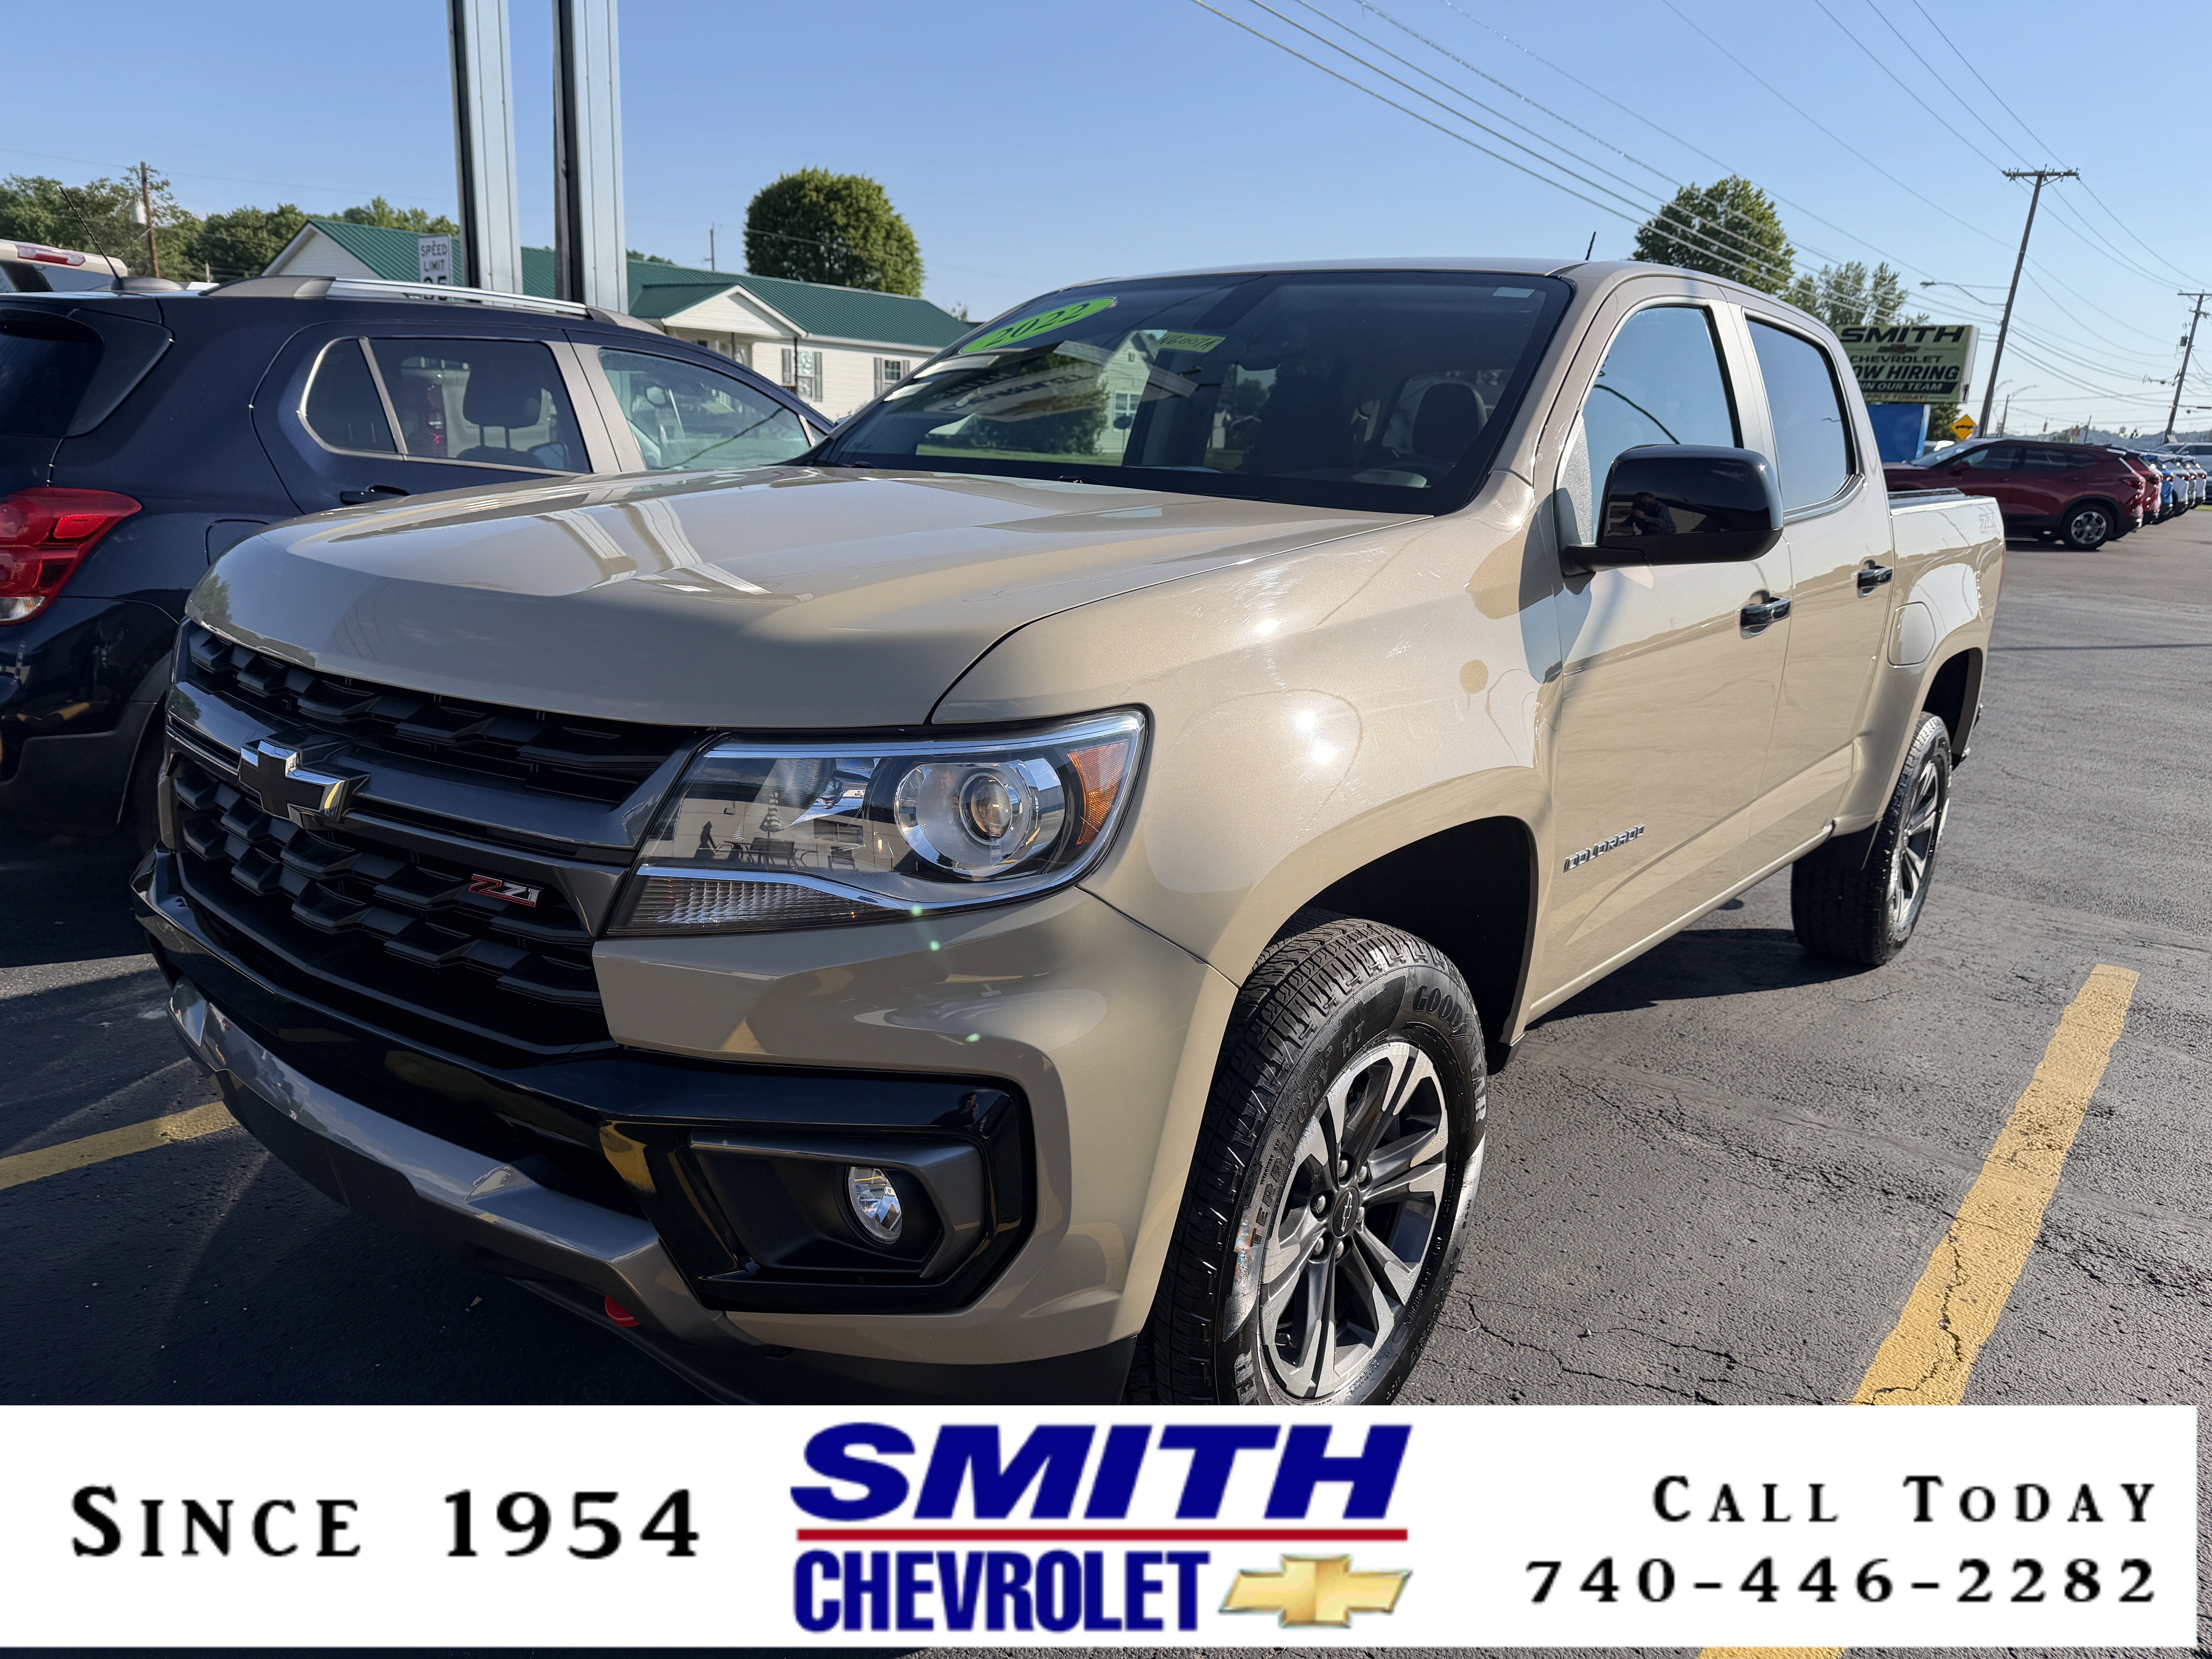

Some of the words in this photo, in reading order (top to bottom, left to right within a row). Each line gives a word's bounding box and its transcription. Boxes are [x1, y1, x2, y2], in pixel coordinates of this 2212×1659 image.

[421, 244, 447, 257] SPEED
[423, 259, 445, 272] LIMIT
[981, 302, 1090, 349] 2022
[1839, 327, 1965, 343] SMITH
[1850, 355, 1943, 364] CHEVROLET
[1853, 365, 1884, 379] OW
[1886, 366, 1960, 380] HIRING
[1877, 382, 1905, 391] OUR
[1908, 382, 1944, 392] TEAM
[1563, 823, 1646, 873] COLORADO
[468, 873, 540, 907] Z71
